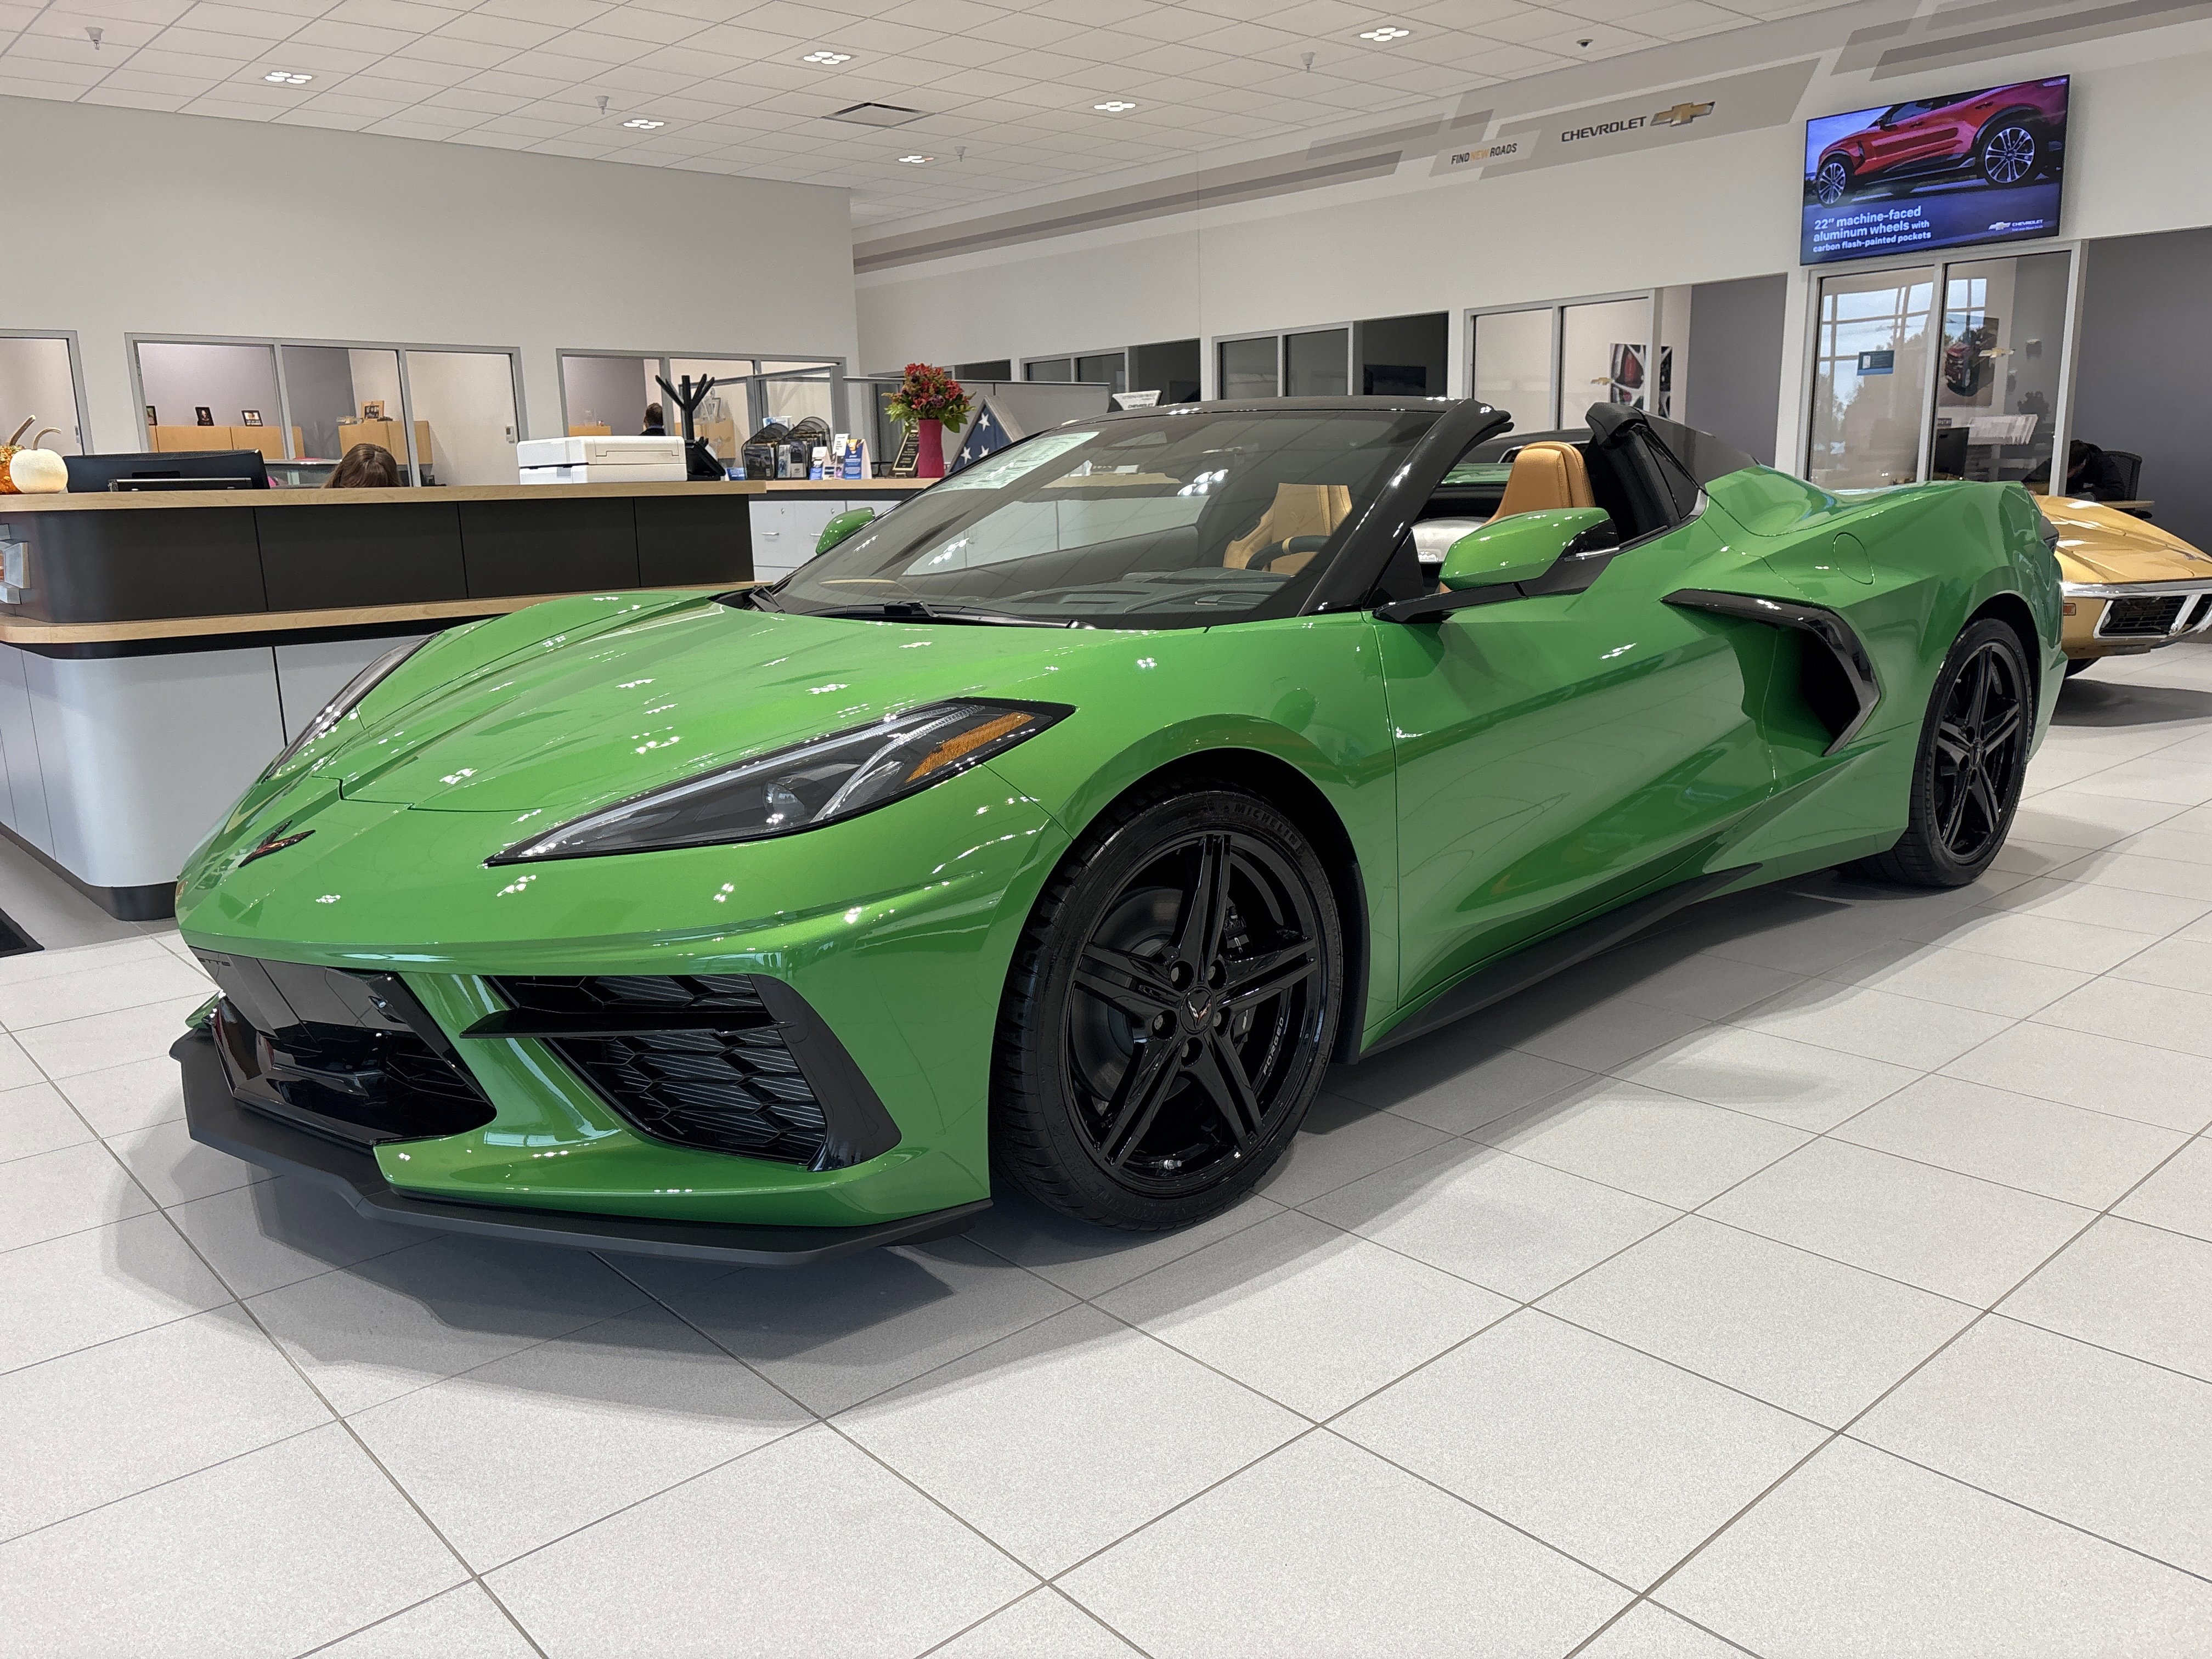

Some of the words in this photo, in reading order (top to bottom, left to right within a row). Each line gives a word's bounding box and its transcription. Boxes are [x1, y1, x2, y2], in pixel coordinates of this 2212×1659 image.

[1561, 116, 1647, 142] CHEVROLET
[1451, 152, 1470, 165] FIND
[1470, 148, 1490, 160] NEW
[1489, 143, 1517, 157] ROADS
[1836, 205, 1922, 227] machine-faced
[1813, 227, 1867, 242] aluminum
[1870, 220, 1910, 235] wheels
[1911, 219, 1930, 229] with
[1813, 243, 1841, 252] carbon
[1842, 234, 1897, 248] flash-painted
[1898, 231, 1932, 244] pockets
[1234, 803, 1301, 849] MICHELIN
[1263, 1017, 1284, 1076] FORGED
